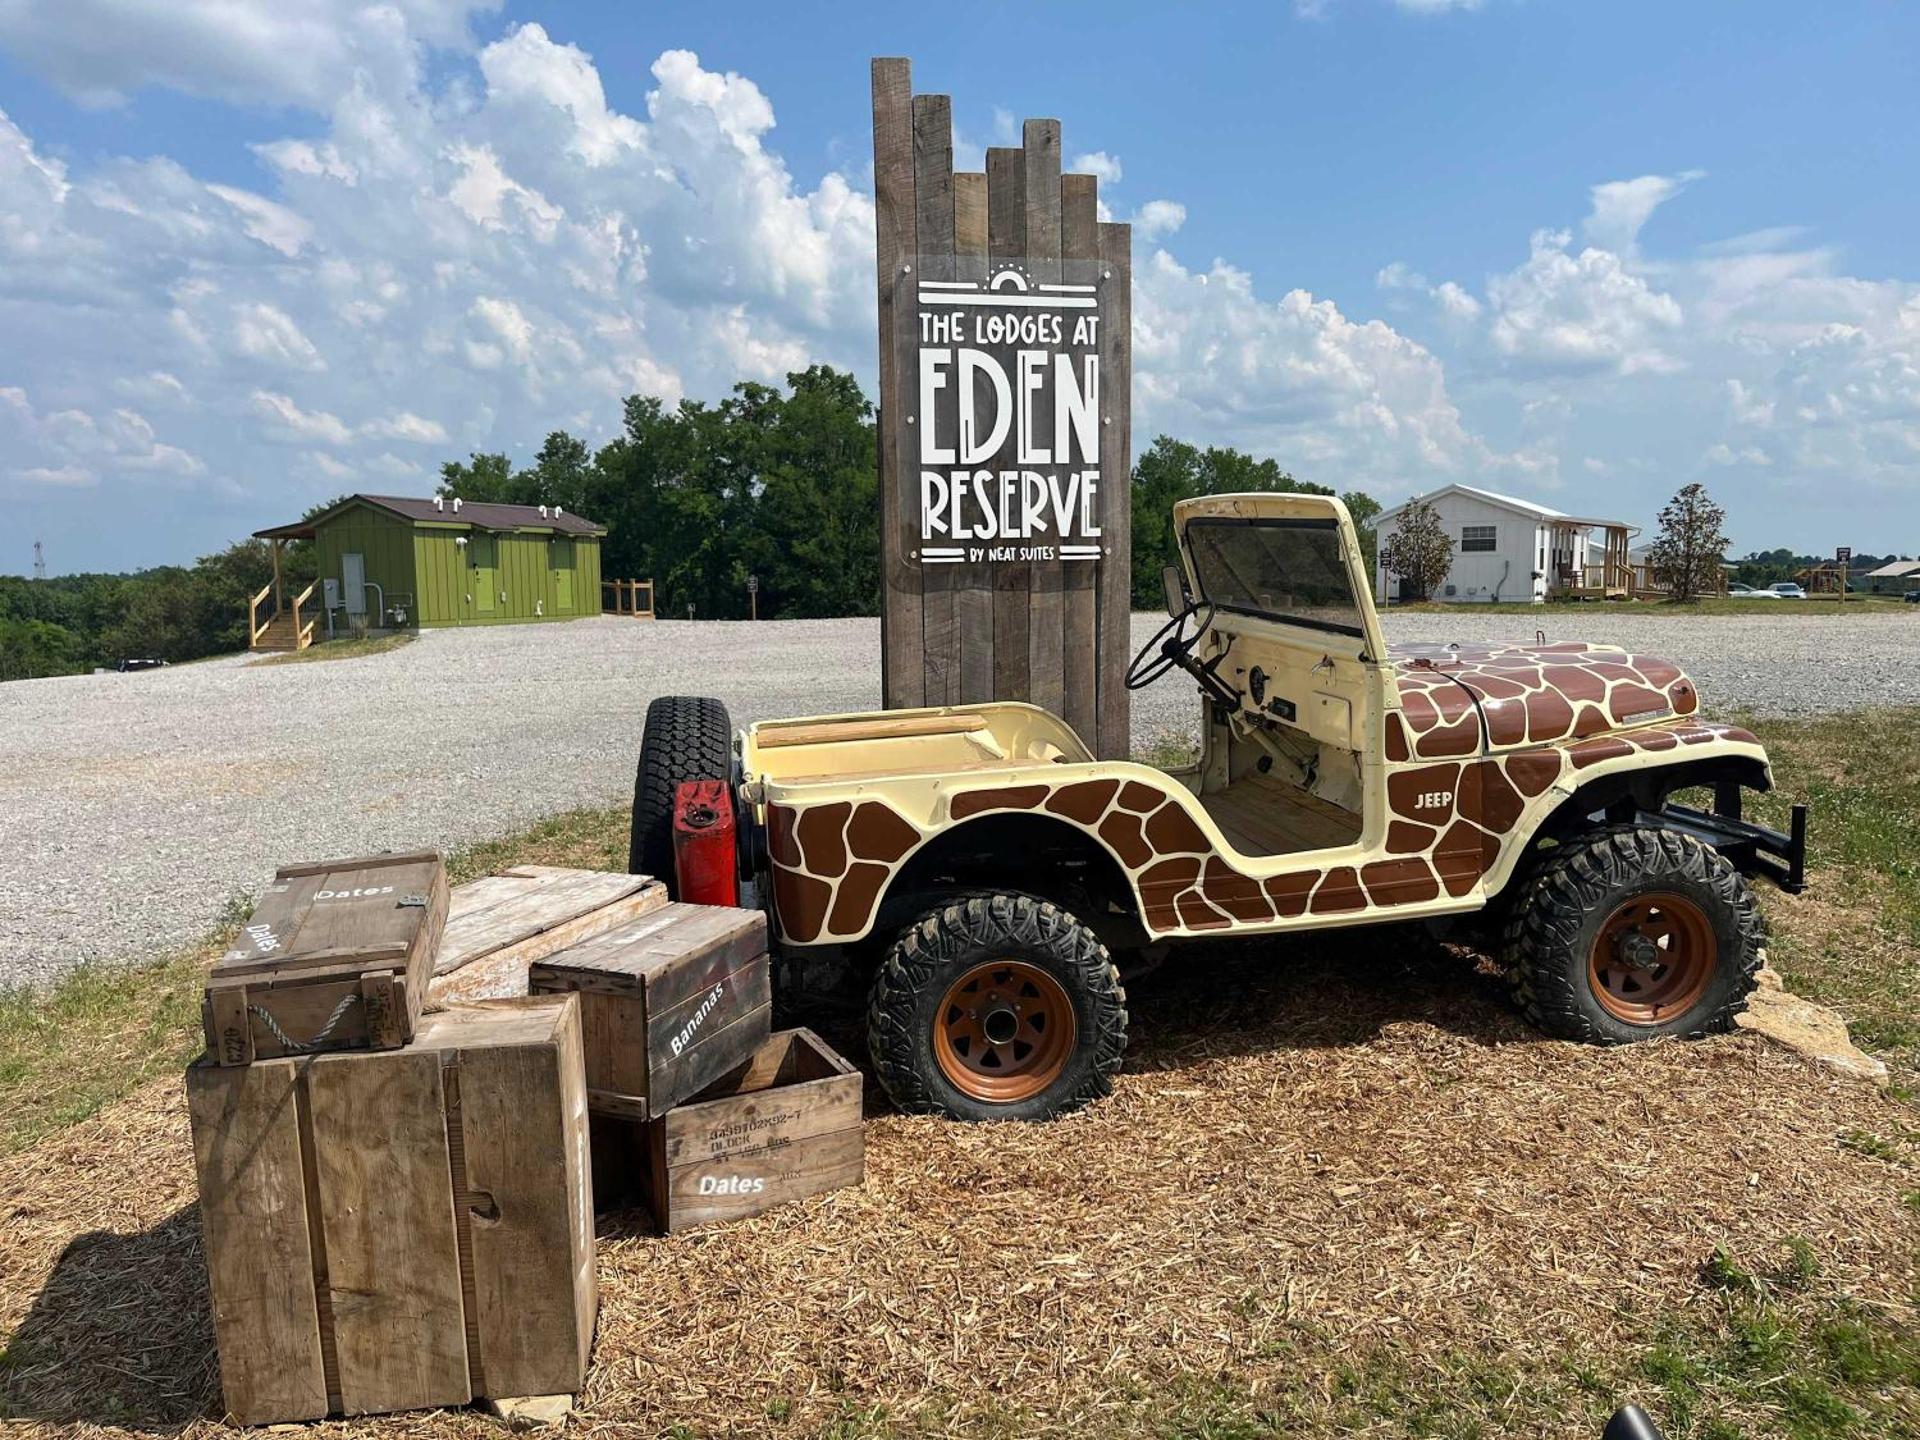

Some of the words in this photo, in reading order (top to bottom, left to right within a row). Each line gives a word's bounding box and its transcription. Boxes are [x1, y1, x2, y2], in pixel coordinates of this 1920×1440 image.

[919, 312, 965, 343] THE
[976, 313, 1063, 345] LODGES
[1072, 316, 1099, 345] AT
[919, 348, 1099, 464] EDEN
[921, 470, 1102, 540] RESERVE
[969, 547, 984, 562] BY
[988, 546, 1016, 562] NEAT
[1020, 546, 1055, 560] SUITES
[1414, 791, 1453, 809] JEEP
[313, 886, 394, 901] Dates
[245, 923, 281, 952] Dates
[670, 981, 724, 1056] Bananas
[699, 1174, 765, 1195] Dates
